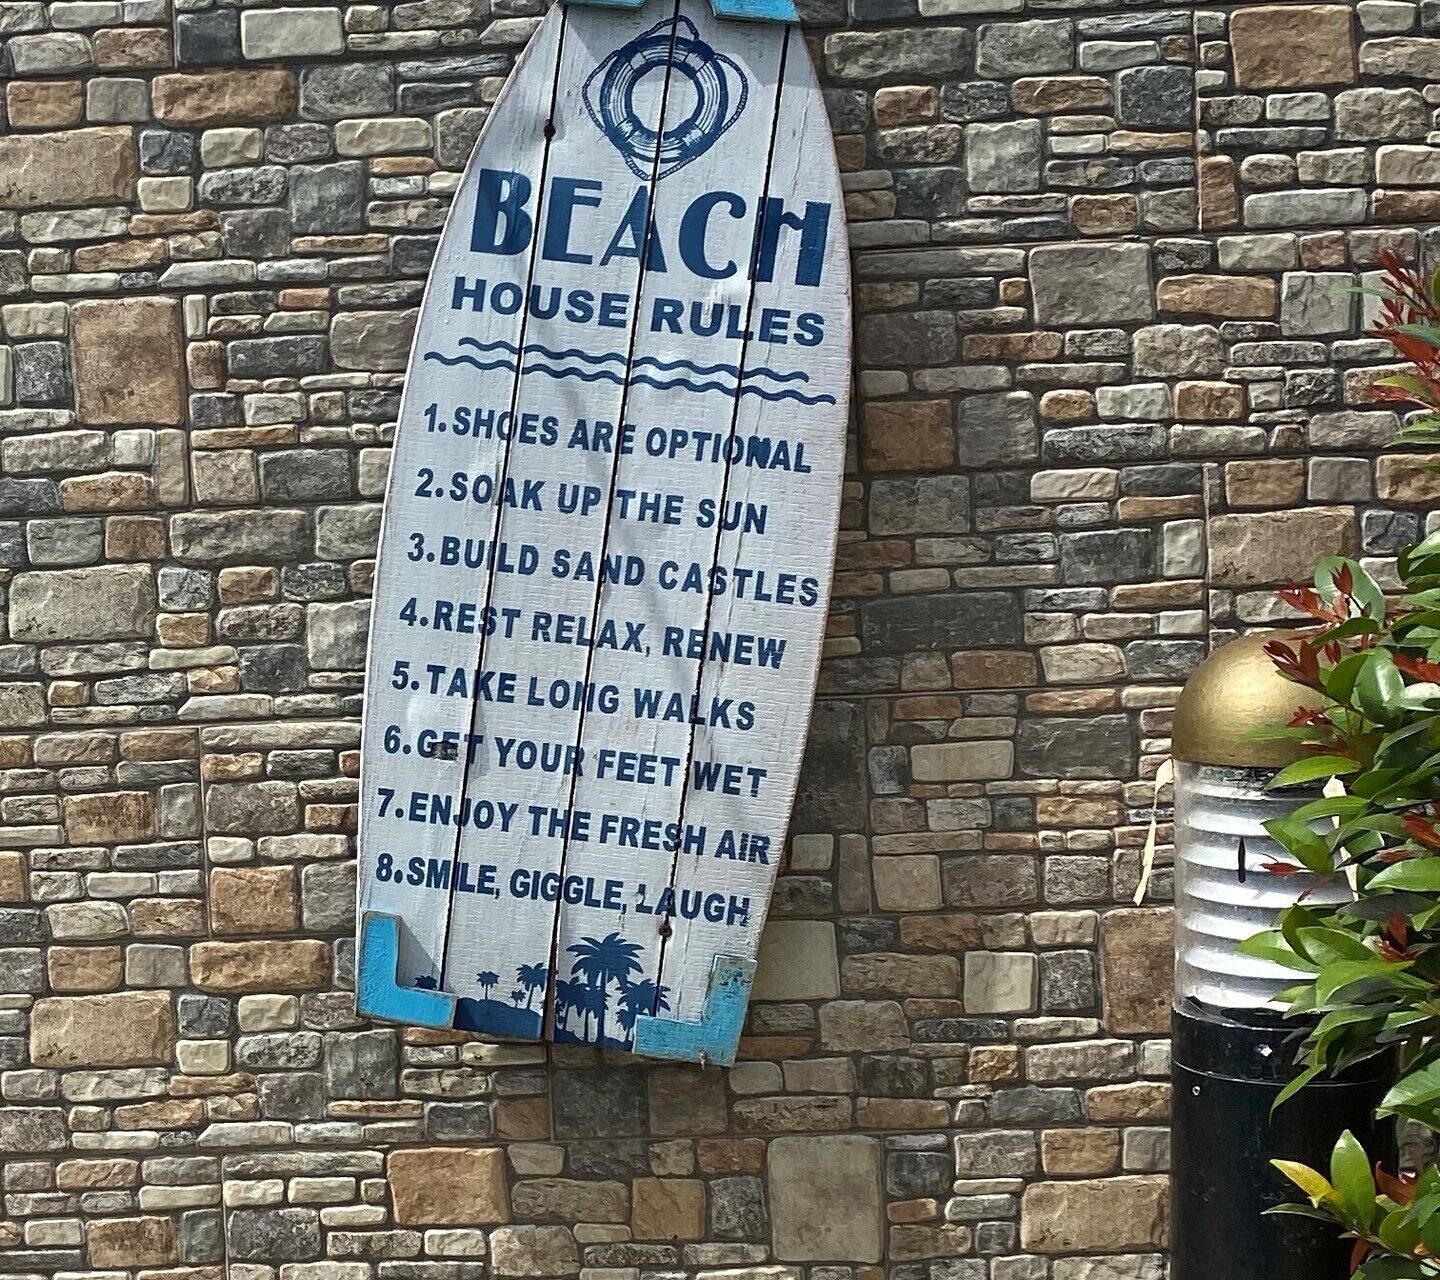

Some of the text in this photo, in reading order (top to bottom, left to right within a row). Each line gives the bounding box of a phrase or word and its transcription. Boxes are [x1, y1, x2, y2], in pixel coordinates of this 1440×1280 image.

[470, 168, 831, 287] BEACH
[451, 276, 825, 346] HOUSE RULES
[567, 419, 633, 454] ARE
[646, 427, 811, 473] OPTIONAL
[558, 485, 601, 516] UP
[616, 489, 684, 525] THE
[697, 498, 767, 534] SUN
[551, 550, 644, 586] SAND
[660, 560, 819, 607] CASTLES
[531, 611, 651, 657] RELAX,
[663, 626, 786, 669] RENEW
[527, 677, 619, 714] LONG
[634, 688, 756, 731] WALKS
[495, 737, 585, 776] YOUR
[597, 750, 680, 787] FEET
[693, 761, 767, 797] WET
[529, 805, 591, 841] THE
[599, 814, 706, 855] FRESH
[714, 829, 771, 865] AIR
[509, 869, 627, 915] GIGGLE,
[635, 883, 751, 926] LAUGH
